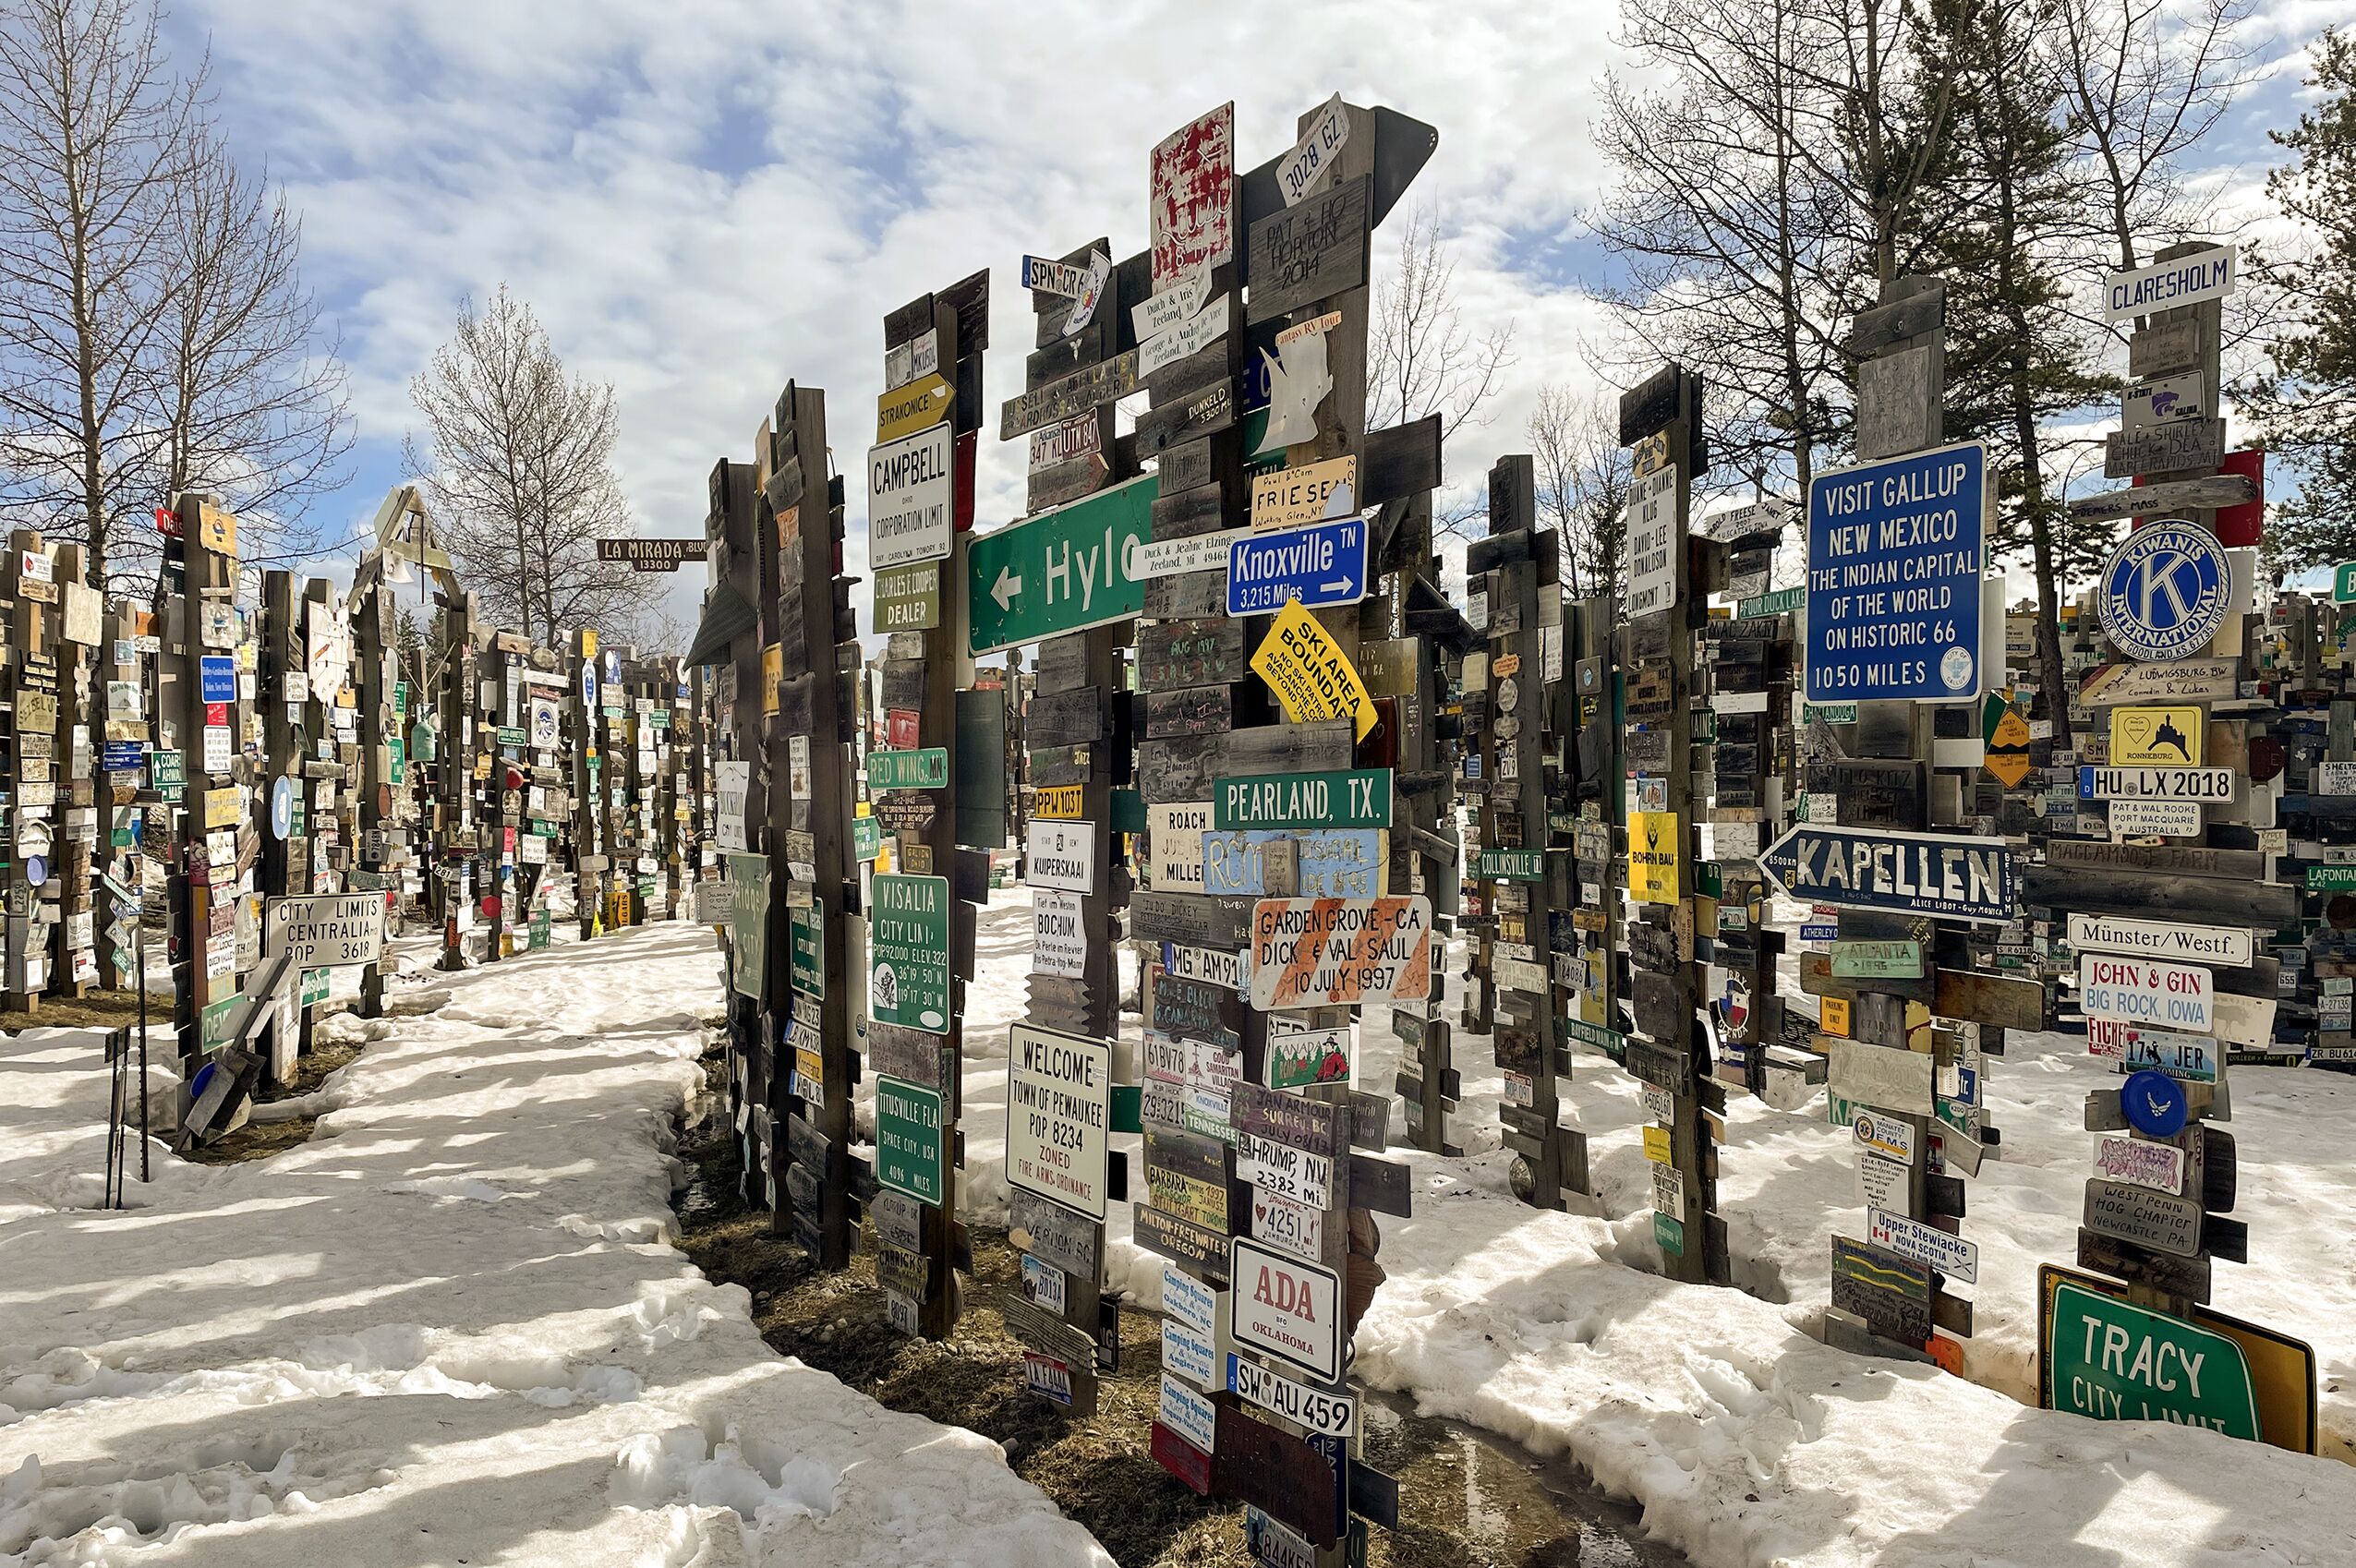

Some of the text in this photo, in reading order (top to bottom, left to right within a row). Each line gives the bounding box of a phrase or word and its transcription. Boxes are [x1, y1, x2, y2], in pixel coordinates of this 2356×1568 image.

[1285, 115, 1341, 198] 3028 GZ
[1032, 262, 1076, 295] SPN CR
[2112, 259, 2228, 311] CLARESHOLM
[1276, 313, 1341, 345] Fantasy RV Tour
[880, 394, 929, 428] STRAKONICE
[874, 443, 946, 495] CAMPBELL
[1825, 463, 1966, 517] VISIT GALLUP
[876, 503, 943, 540] CORPORATION LIMIT
[1830, 509, 1957, 558] NEW MEXICO
[605, 541, 683, 559] LA MIRADA
[640, 560, 671, 569] 13300
[1237, 526, 1356, 584] Knoxville TN
[2125, 534, 2206, 568] KIWANIS
[1811, 549, 1977, 592] THE INDIAN CAPITAL
[1240, 582, 1303, 609] 3,215 Miles
[1743, 588, 1806, 617] FOUR DUCK LAKE
[1831, 585, 1951, 620] OF THE WORLD
[888, 601, 926, 625] DEALER
[2111, 584, 2217, 647] INTERNATIONAL
[1826, 619, 1956, 651] ON HISTORIC 66
[1266, 651, 1310, 709] AVALANCHE
[1298, 621, 1360, 716] SKI AREA
[1815, 660, 1927, 689] 1050 MILES
[870, 757, 892, 785] RED
[930, 754, 943, 780] MN
[2126, 752, 2173, 760] RONNEBURG
[2095, 771, 2230, 797] HU LX 2018
[1037, 790, 1081, 814] PPW 103T
[1227, 778, 1382, 822] PEARLAND, TX.
[2113, 803, 2196, 814] PAT & WAL ROOKE
[1168, 812, 1206, 830] ROACH
[2114, 814, 2195, 826] PORT MACQUARIE
[2128, 825, 2181, 835] AUSTRALIA
[1033, 857, 1084, 880] KUIPERSKAAI
[1481, 852, 1529, 876] COLLINSVILLE
[1633, 850, 1673, 866] BOHRN BAU
[1796, 838, 2000, 905] KAPELLEN
[883, 881, 935, 913] VISALIA
[2003, 852, 2012, 914] BELGIUM
[280, 899, 378, 922] CITY LIMITS
[1911, 899, 1931, 909] ALICE
[288, 921, 369, 942] CENTRALIA
[880, 919, 903, 941] CITY
[1038, 913, 1076, 938] BOCHUM
[1261, 908, 1420, 935] GARDEN GROVE CA
[1803, 927, 1832, 938] ATHERLEY
[285, 940, 369, 961] POP 3618
[1262, 937, 1411, 966] DICK & VAL SAUL
[1849, 944, 1912, 959] ATLANTA
[2083, 923, 2235, 956] Münster/Westf.
[1173, 944, 1222, 981] MG AM
[1295, 967, 1395, 995] 10 JULY 1997
[2091, 962, 2202, 995] JOHN & GIN
[2279, 974, 2295, 985] 655
[1825, 999, 1844, 1012] PARKING
[2086, 988, 2205, 1025] BIG ROCK, IOWA
[1213, 1051, 1229, 1063] GOOD
[1276, 1040, 1323, 1055] CANADA
[2128, 1041, 2203, 1070] 17 JER
[2311, 1049, 2342, 1060] ZR BU
[1023, 1039, 1095, 1089] WELCOME
[1205, 1061, 1239, 1079] SAMARITAN
[1013, 1080, 1103, 1129] TOWN OF PEWAUKEE
[1195, 1094, 1228, 1114] KNOXVILLE
[1030, 1113, 1083, 1152] POP 8234
[1189, 1115, 1236, 1141] TENNESSEE
[1876, 1128, 1903, 1140] COUNTY
[1039, 1145, 1070, 1169] ZONED
[1238, 1132, 1327, 1188] PAHRUMP, NV
[1018, 1158, 1092, 1202] FIRE ARMS ORDINANCE
[1140, 1210, 1228, 1257] MILTON-FREEWATER
[1268, 1207, 1303, 1241] 4251
[1879, 1213, 1967, 1257] Upper Stewiacke
[1161, 1235, 1206, 1261] OREGON
[1895, 1235, 1947, 1262] NOVA SCOTIA
[1164, 1270, 1214, 1309] Camping Squares
[1253, 1265, 1316, 1323] ADA
[1164, 1327, 1214, 1361] Camping Squares
[1252, 1321, 1314, 1356] OKLAHOMA
[2082, 1314, 2205, 1399] TRACY
[1164, 1382, 1213, 1424] Camping Squares
[1238, 1364, 1349, 1433] SW AU 459
[2072, 1375, 2122, 1420] CITY
